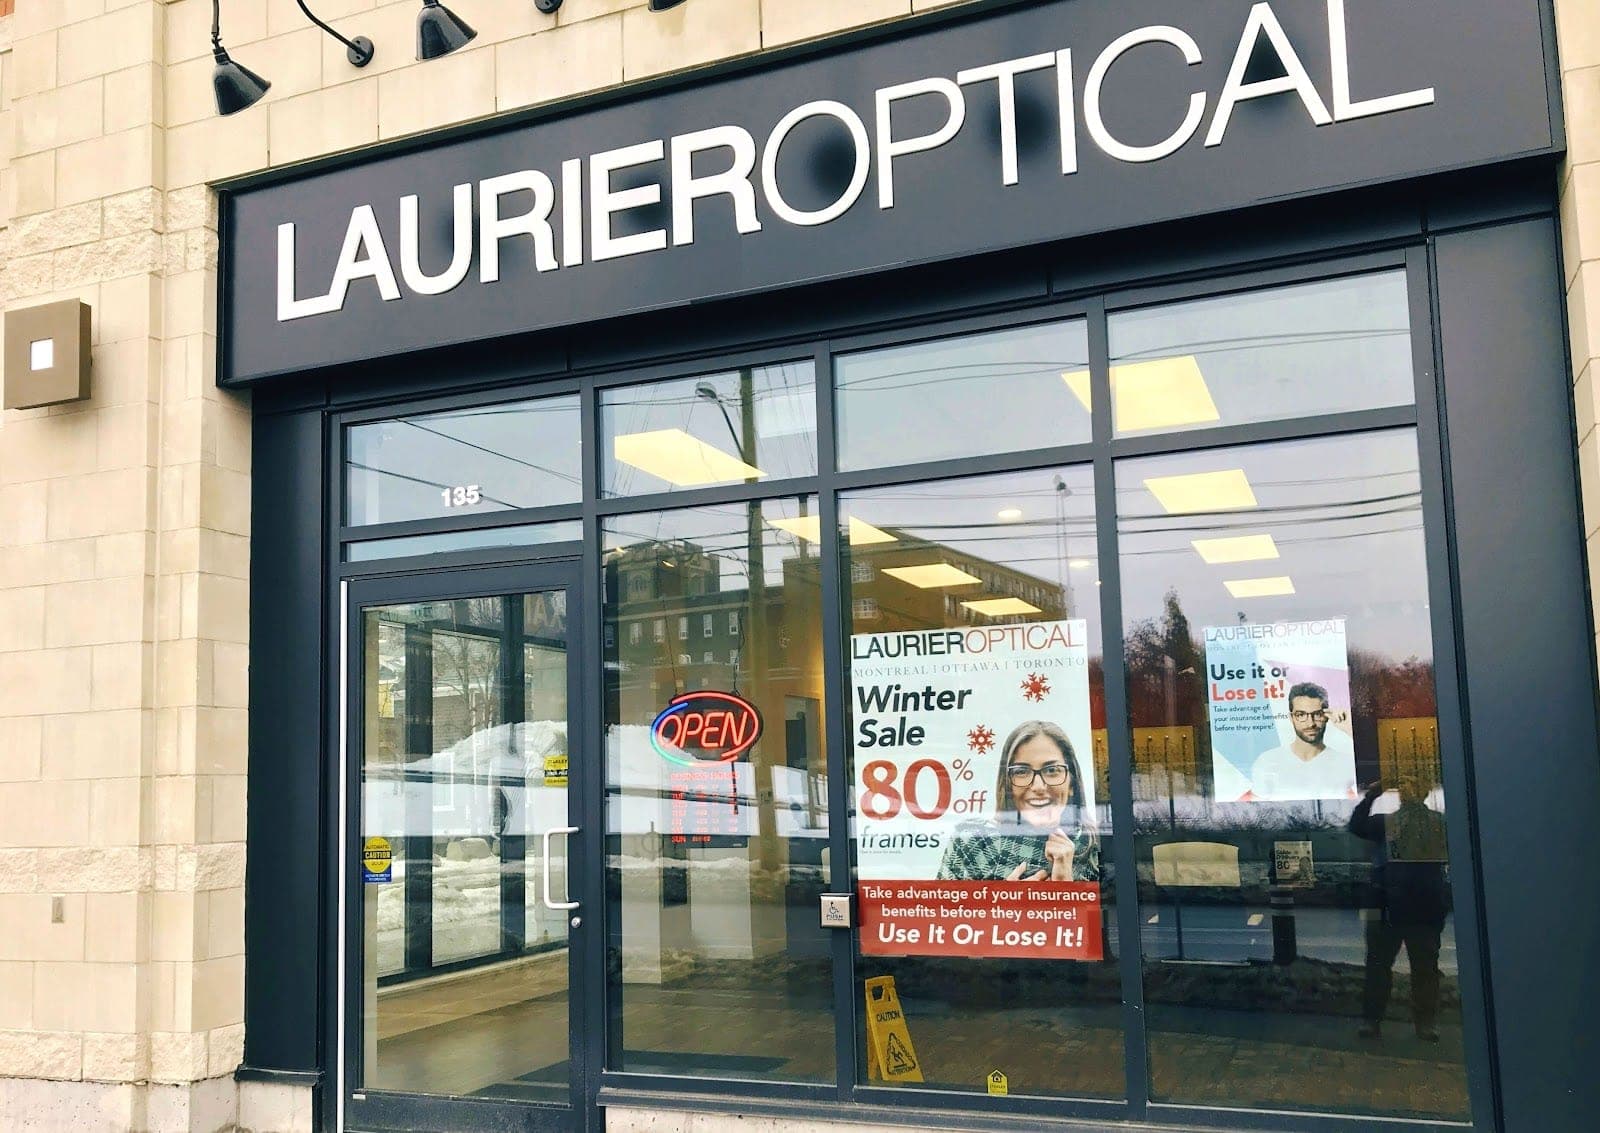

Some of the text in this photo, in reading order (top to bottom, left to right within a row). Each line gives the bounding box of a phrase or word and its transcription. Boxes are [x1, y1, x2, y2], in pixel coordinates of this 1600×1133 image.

[441, 485, 480, 507] 135
[854, 664, 928, 677] MONTREAL
[941, 661, 1000, 674] OTTAWA
[1013, 657, 1086, 669] TORONTO
[1210, 662, 1289, 681] Use it or
[857, 684, 972, 713] Winter
[1212, 680, 1286, 702] Lose it!
[1229, 705, 1260, 713] advantage
[657, 711, 748, 748] OPEN
[857, 716, 926, 747] Sale
[1236, 723, 1251, 732] they
[860, 759, 952, 820] 80
[953, 790, 987, 814] off
[863, 886, 1097, 903] Take advantage of your insurance
[881, 904, 1077, 923] benefits before they expire!
[878, 922, 1083, 947] Use It Or Lose It!
[877, 1009, 901, 1022] CAUTION
